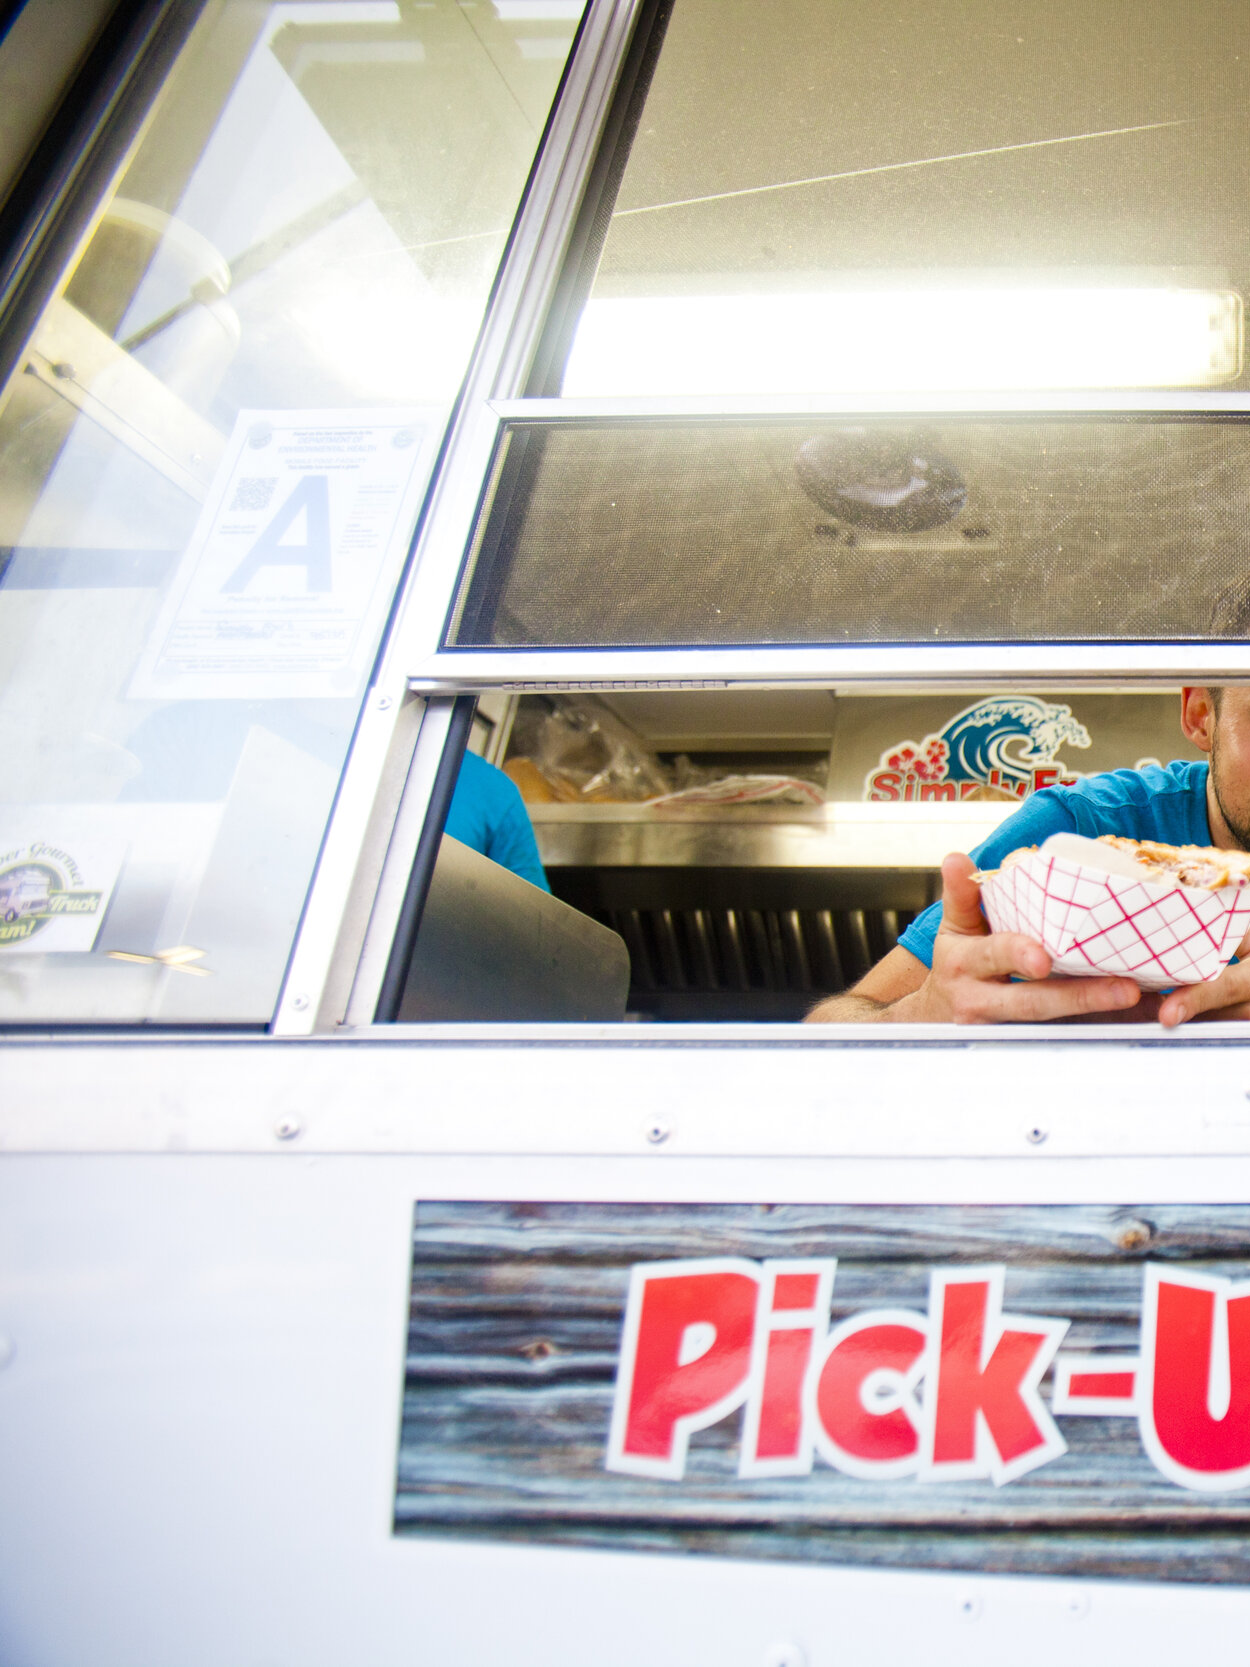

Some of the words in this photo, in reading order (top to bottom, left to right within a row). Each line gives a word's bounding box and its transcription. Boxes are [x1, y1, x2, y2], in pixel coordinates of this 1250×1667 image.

[221, 475, 332, 592] A
[30, 842, 84, 886] Gourmet
[50, 894, 98, 912] Truck
